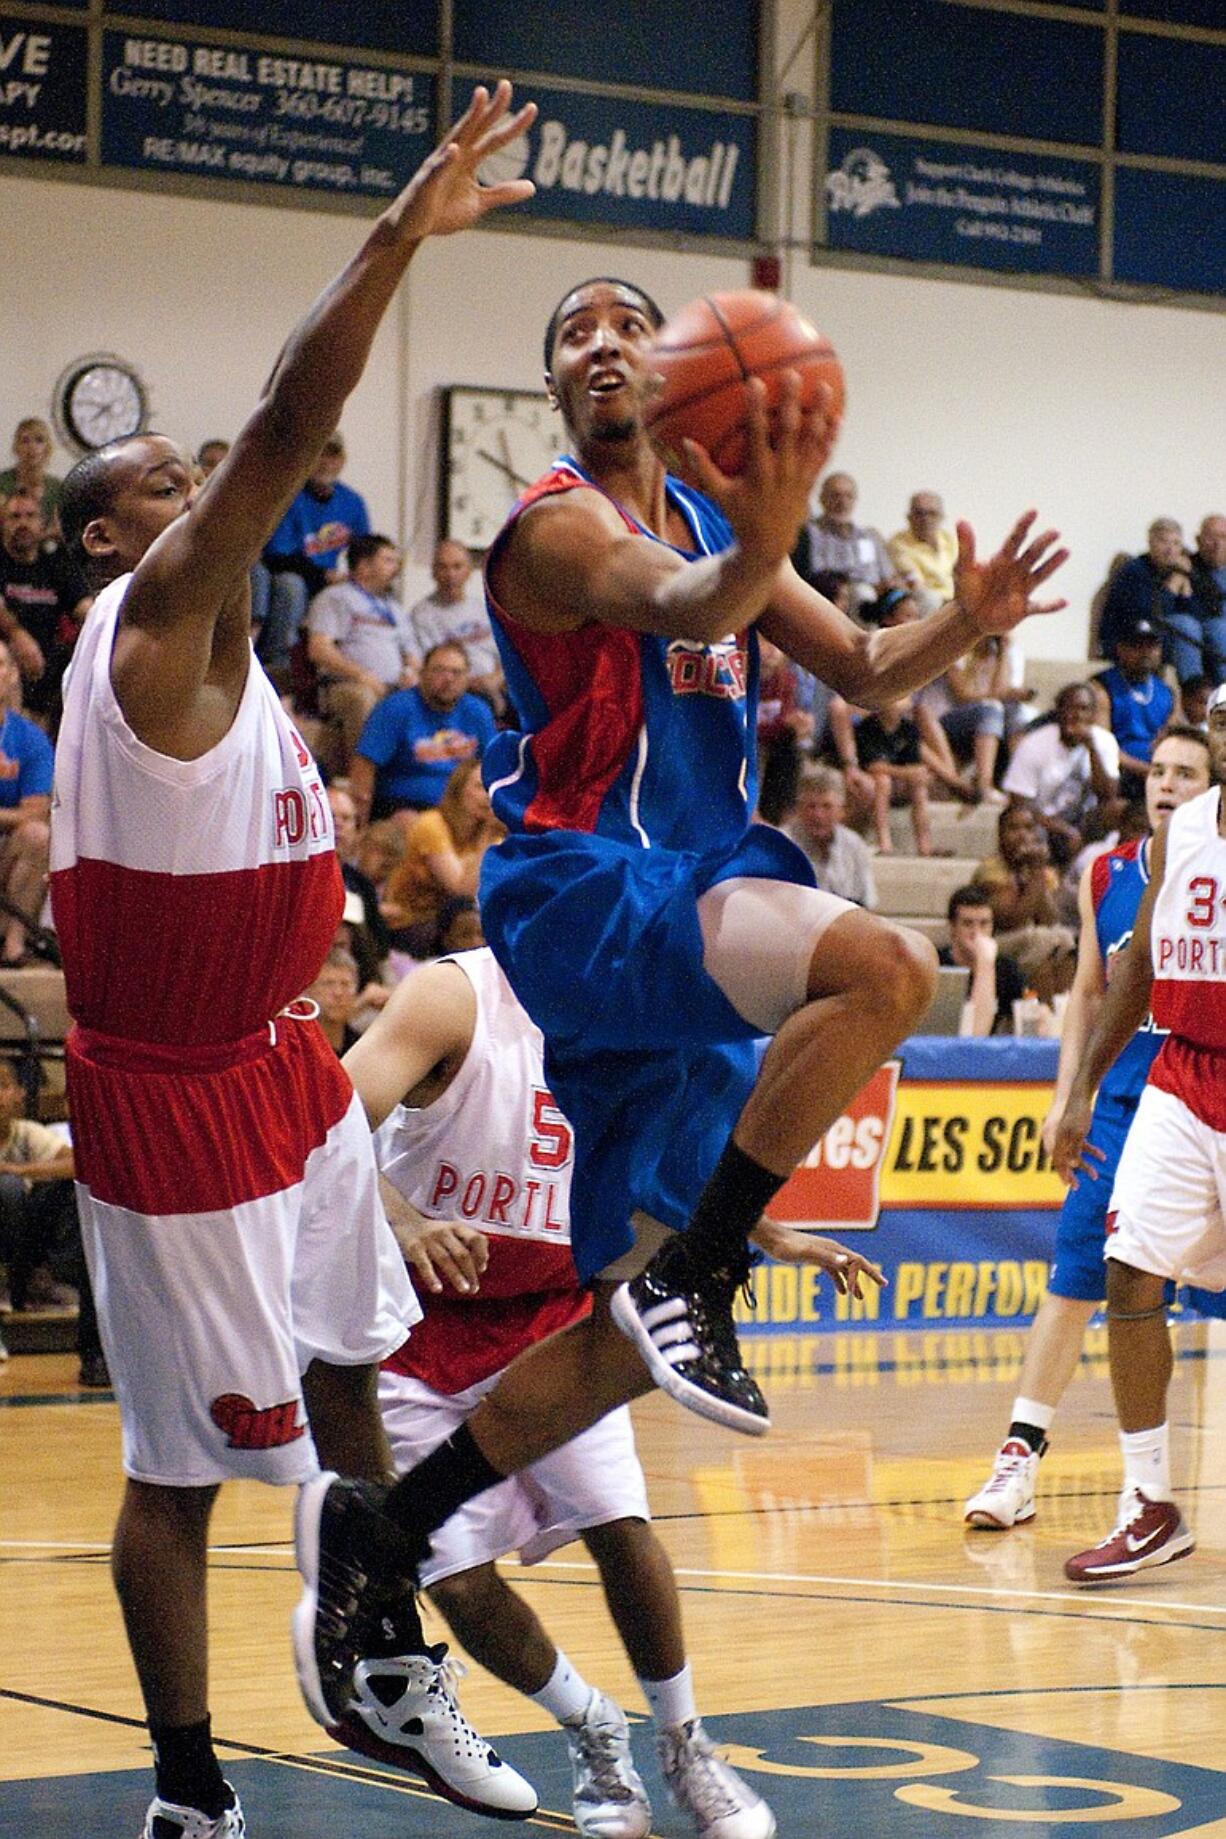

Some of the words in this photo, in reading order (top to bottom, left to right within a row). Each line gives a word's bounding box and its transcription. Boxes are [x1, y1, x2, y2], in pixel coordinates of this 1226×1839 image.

[124, 40, 188, 73] NEED
[194, 48, 252, 82] REAL
[257, 57, 343, 94] ESTATE
[533, 120, 739, 209] Basketball
[893, 1115, 968, 1173] LES
[430, 1162, 563, 1231] PORTL
[834, 1262, 882, 1321] IN
